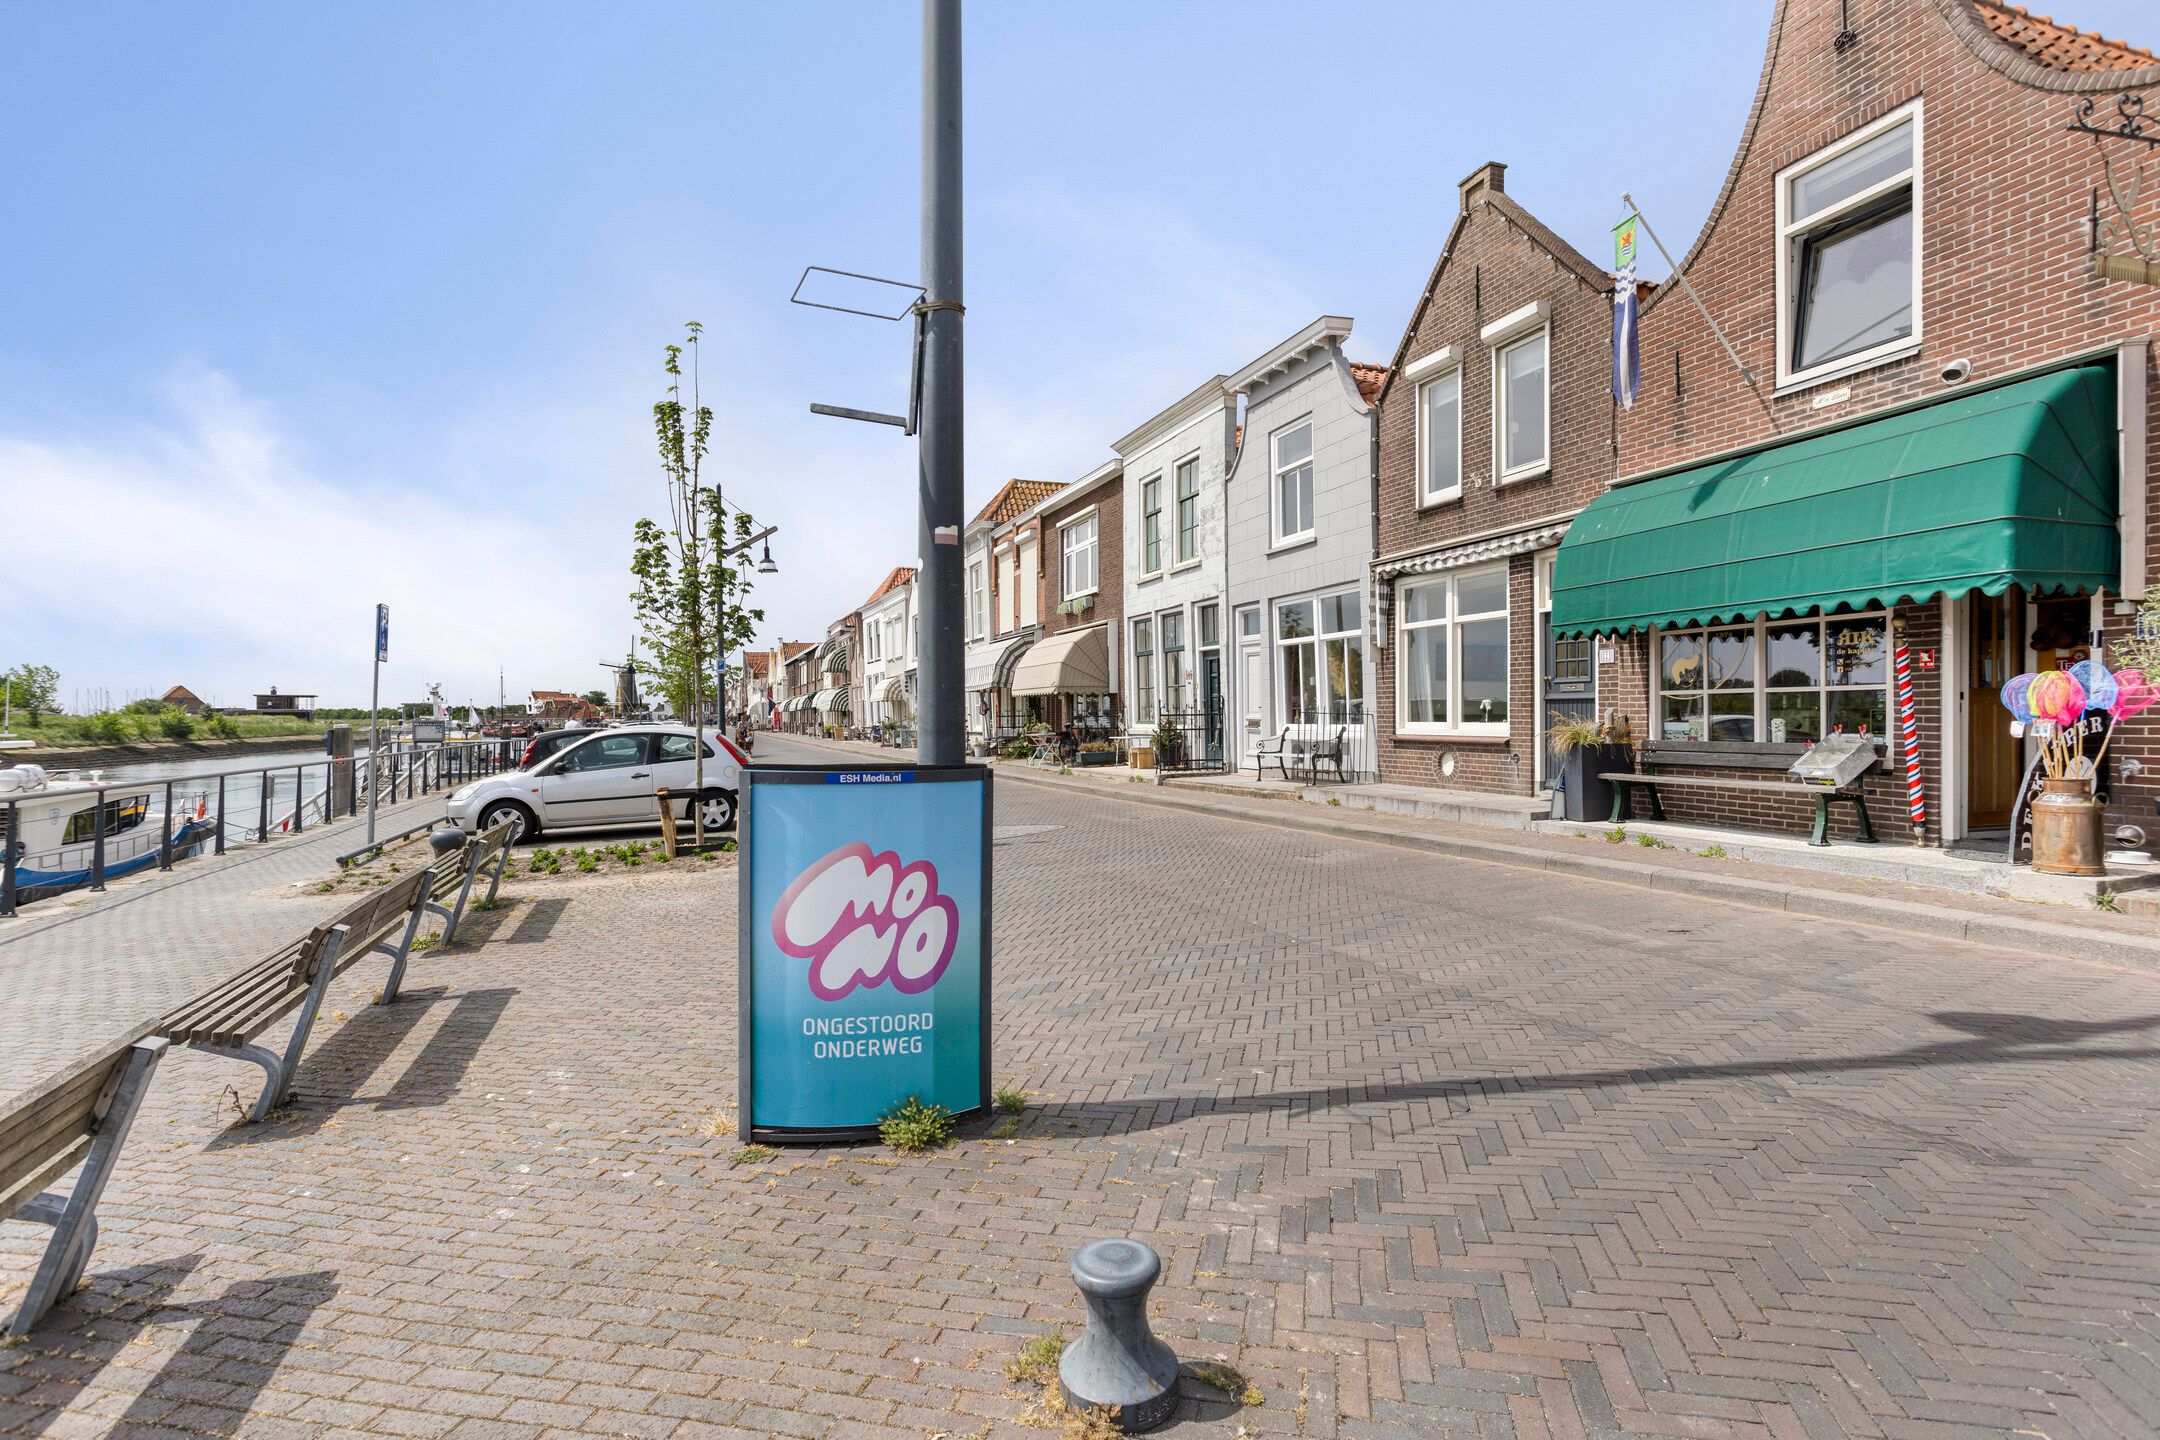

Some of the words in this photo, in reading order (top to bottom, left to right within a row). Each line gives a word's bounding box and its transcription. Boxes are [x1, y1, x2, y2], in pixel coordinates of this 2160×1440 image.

[839, 774, 860, 783] ESH
[862, 773, 902, 783] Media.nl
[785, 854, 928, 947] MO
[819, 904, 948, 990] NO
[802, 1012, 934, 1036] ONGESTOORD
[814, 1036, 922, 1059] ONDERWEG
